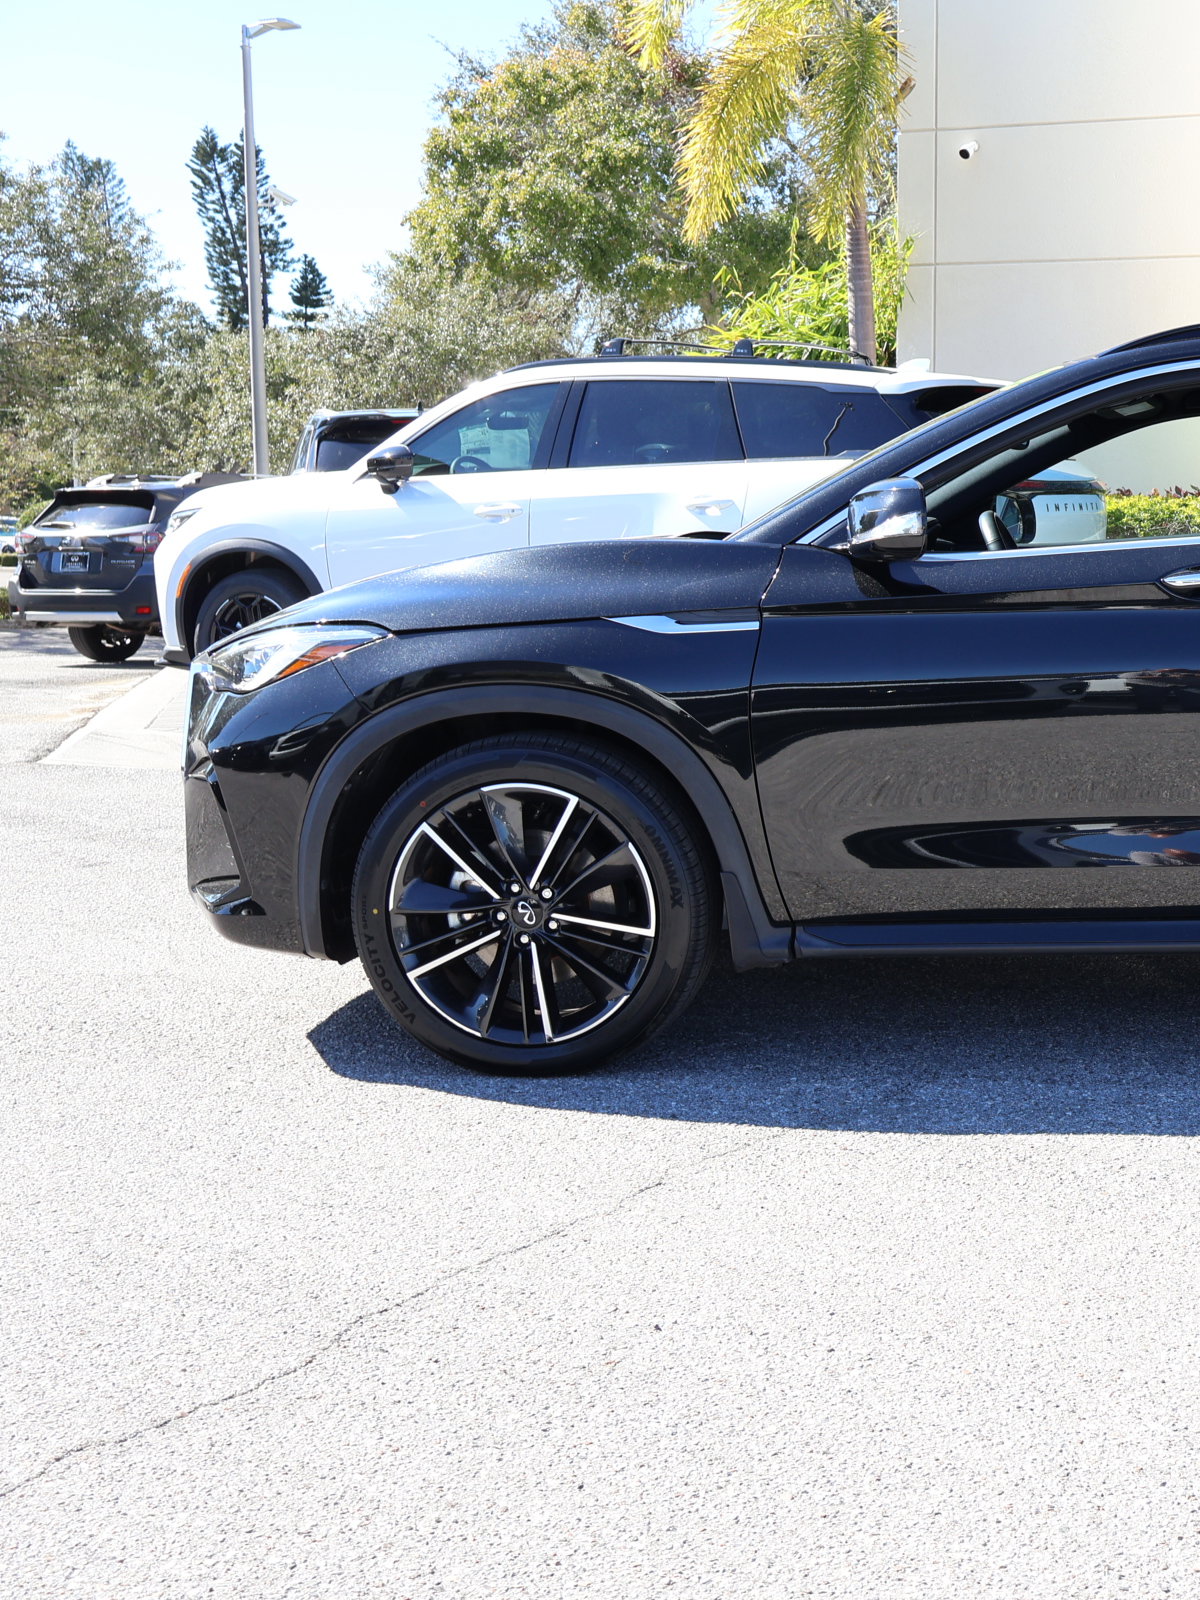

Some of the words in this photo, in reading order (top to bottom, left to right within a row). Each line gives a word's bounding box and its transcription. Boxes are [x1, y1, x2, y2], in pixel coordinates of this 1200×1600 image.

[1046, 502, 1099, 512] INFINITI
[644, 825, 684, 909] OMNIMAX
[365, 934, 416, 1024] VELOCITY
